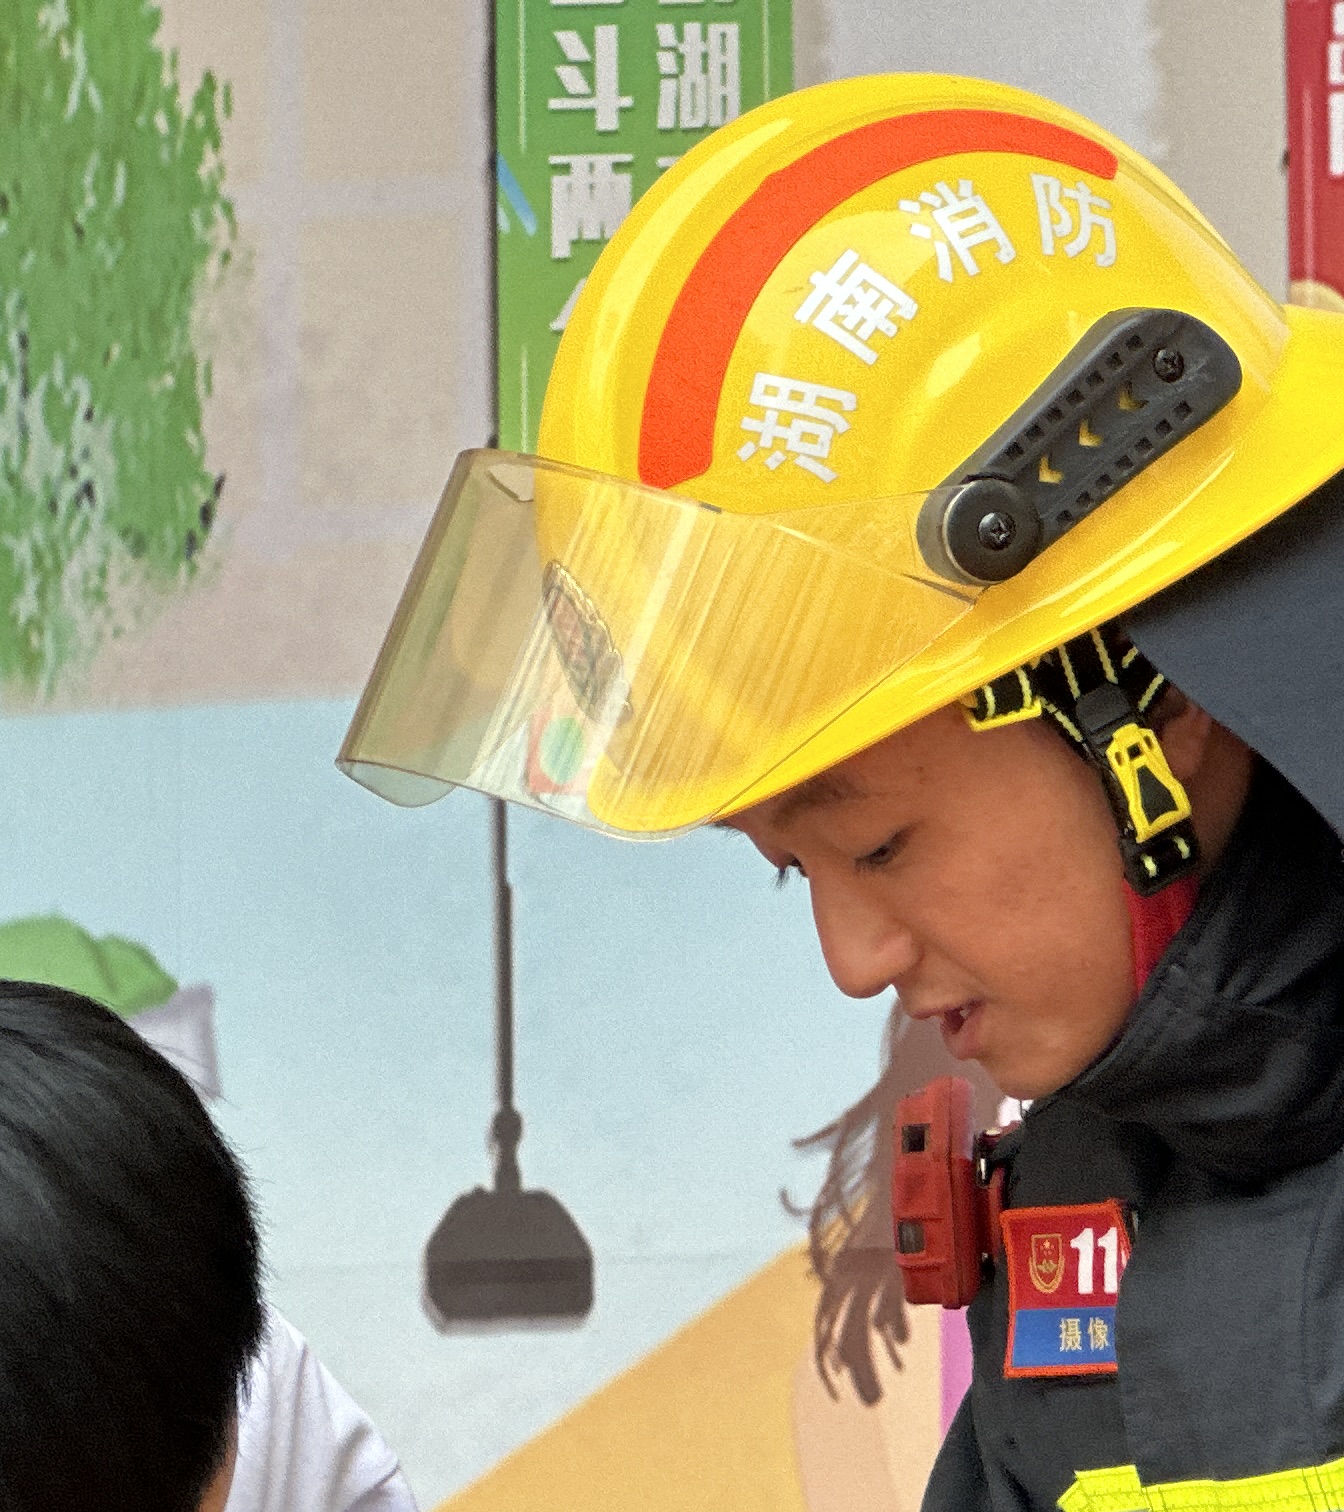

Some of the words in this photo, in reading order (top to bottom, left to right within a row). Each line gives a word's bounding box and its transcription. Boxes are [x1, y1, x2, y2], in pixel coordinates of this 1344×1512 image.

[548, 0, 635, 332] 斗两
[736, 172, 1119, 485] 湖南消防
[1058, 1316, 1110, 1353] 摄像
[1069, 1226, 1129, 1295] 11
